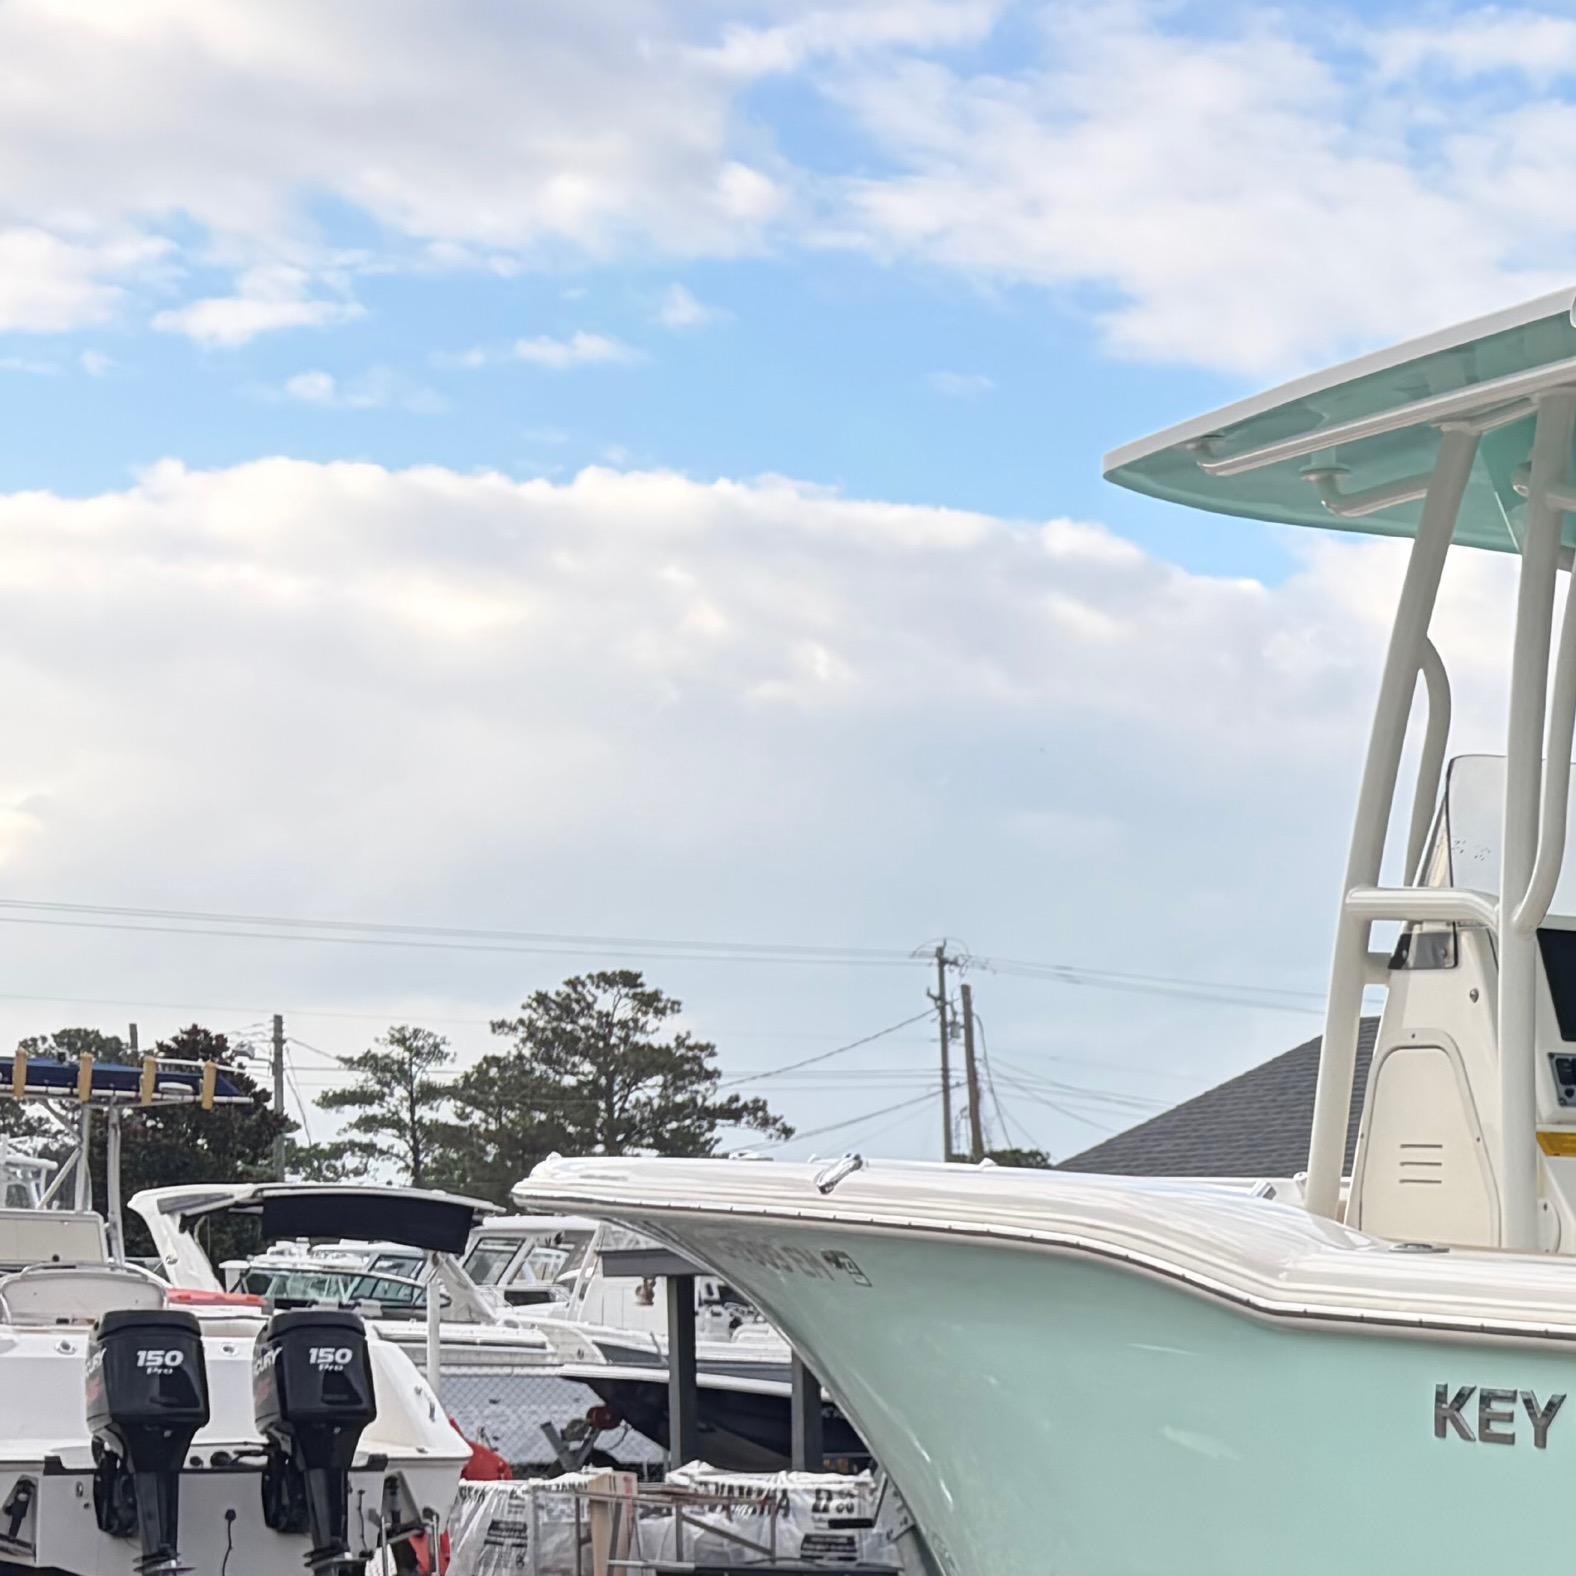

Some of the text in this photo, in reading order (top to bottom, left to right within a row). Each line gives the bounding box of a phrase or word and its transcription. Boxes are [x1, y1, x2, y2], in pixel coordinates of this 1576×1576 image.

[137, 1350, 184, 1367] 150
[309, 1348, 353, 1365] 150
[1433, 1383, 1567, 1450] KEY
